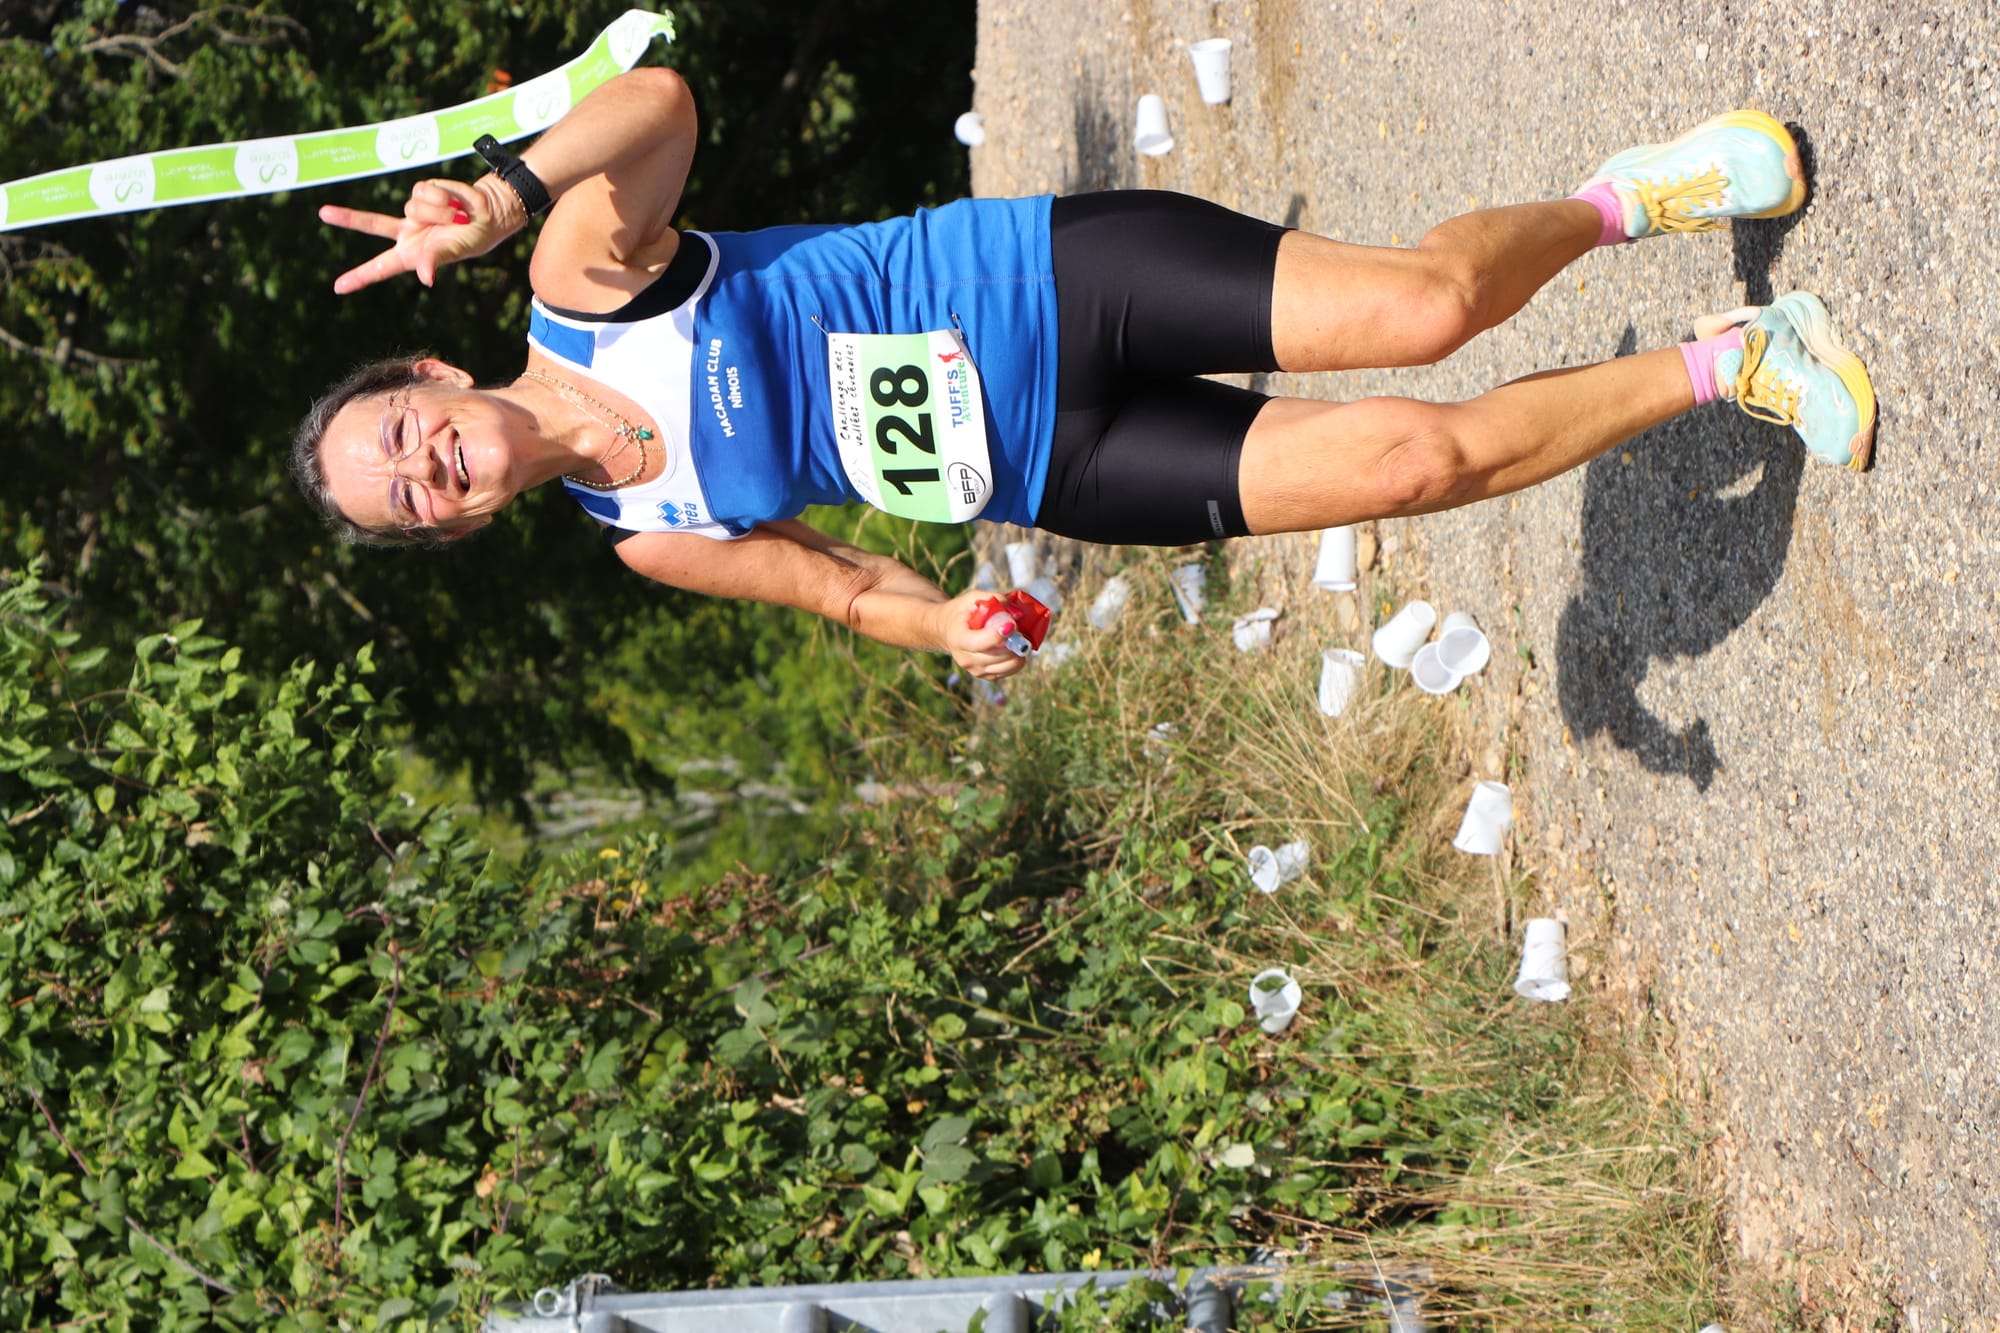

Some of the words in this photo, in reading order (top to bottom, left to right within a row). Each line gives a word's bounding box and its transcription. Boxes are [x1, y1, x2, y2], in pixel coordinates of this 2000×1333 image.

[706, 338, 723, 373] CLUB
[834, 350, 843, 371] des
[707, 375, 736, 438] MACADAM
[725, 366, 743, 409] NÎMOIS
[946, 369, 963, 428] TUFF'S
[957, 361, 972, 422] Aventure
[836, 380, 850, 441] Challenge
[849, 406, 863, 446] vallées
[869, 364, 941, 496] 128
[959, 468, 976, 505] BFP
[683, 502, 701, 526] rrea
